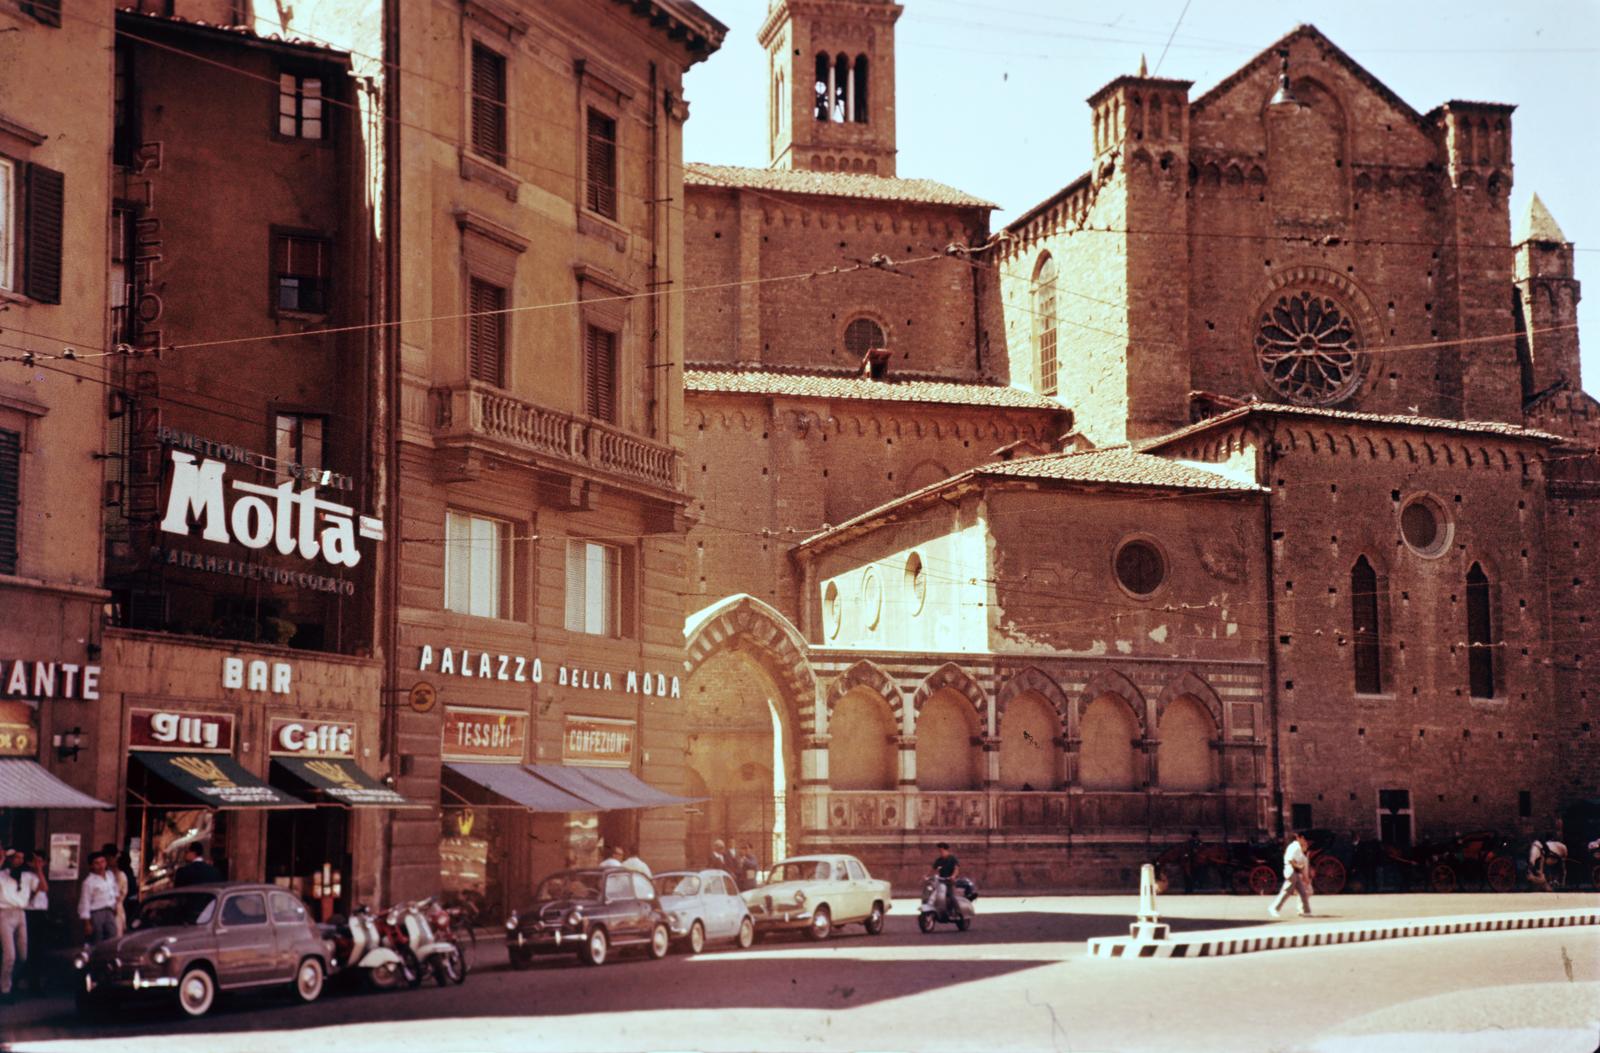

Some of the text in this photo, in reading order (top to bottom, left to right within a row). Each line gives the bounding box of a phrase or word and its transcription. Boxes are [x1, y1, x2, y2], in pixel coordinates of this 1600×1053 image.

[161, 450, 361, 568] Motta
[0, 659, 101, 700] ANTE
[222, 656, 292, 694] BAR
[420, 645, 681, 699] PALAZZO DELLA MODA
[457, 721, 511, 748] TESSUTI
[569, 729, 627, 753] CONFEZIONI
